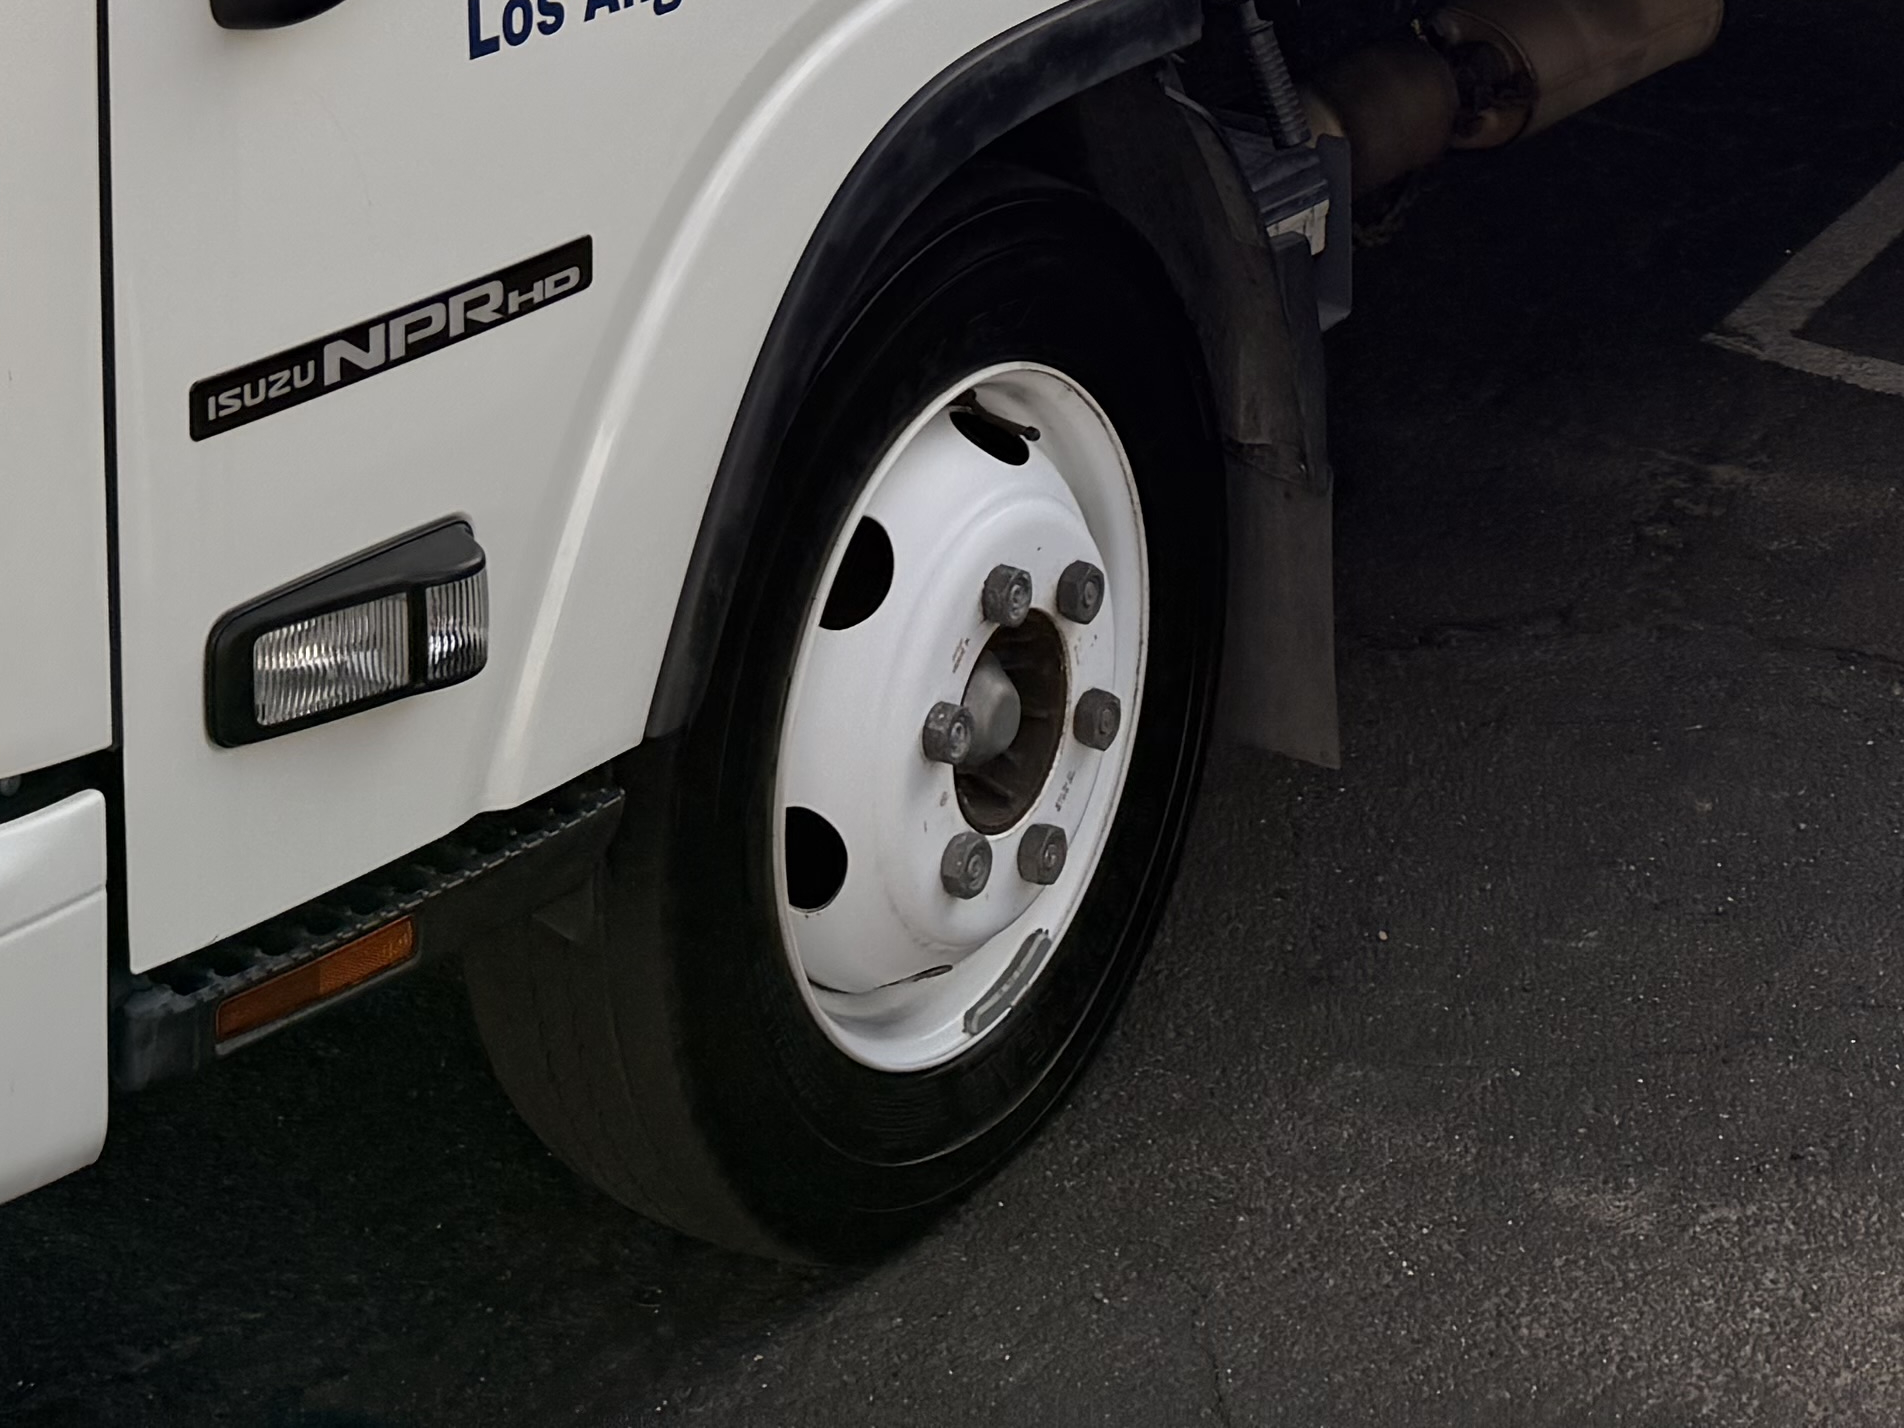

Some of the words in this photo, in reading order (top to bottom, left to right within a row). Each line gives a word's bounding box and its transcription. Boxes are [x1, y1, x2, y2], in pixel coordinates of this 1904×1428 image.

[207, 359, 316, 421] ISUZU
[323, 280, 505, 387] NPR
[507, 265, 581, 314] HD
